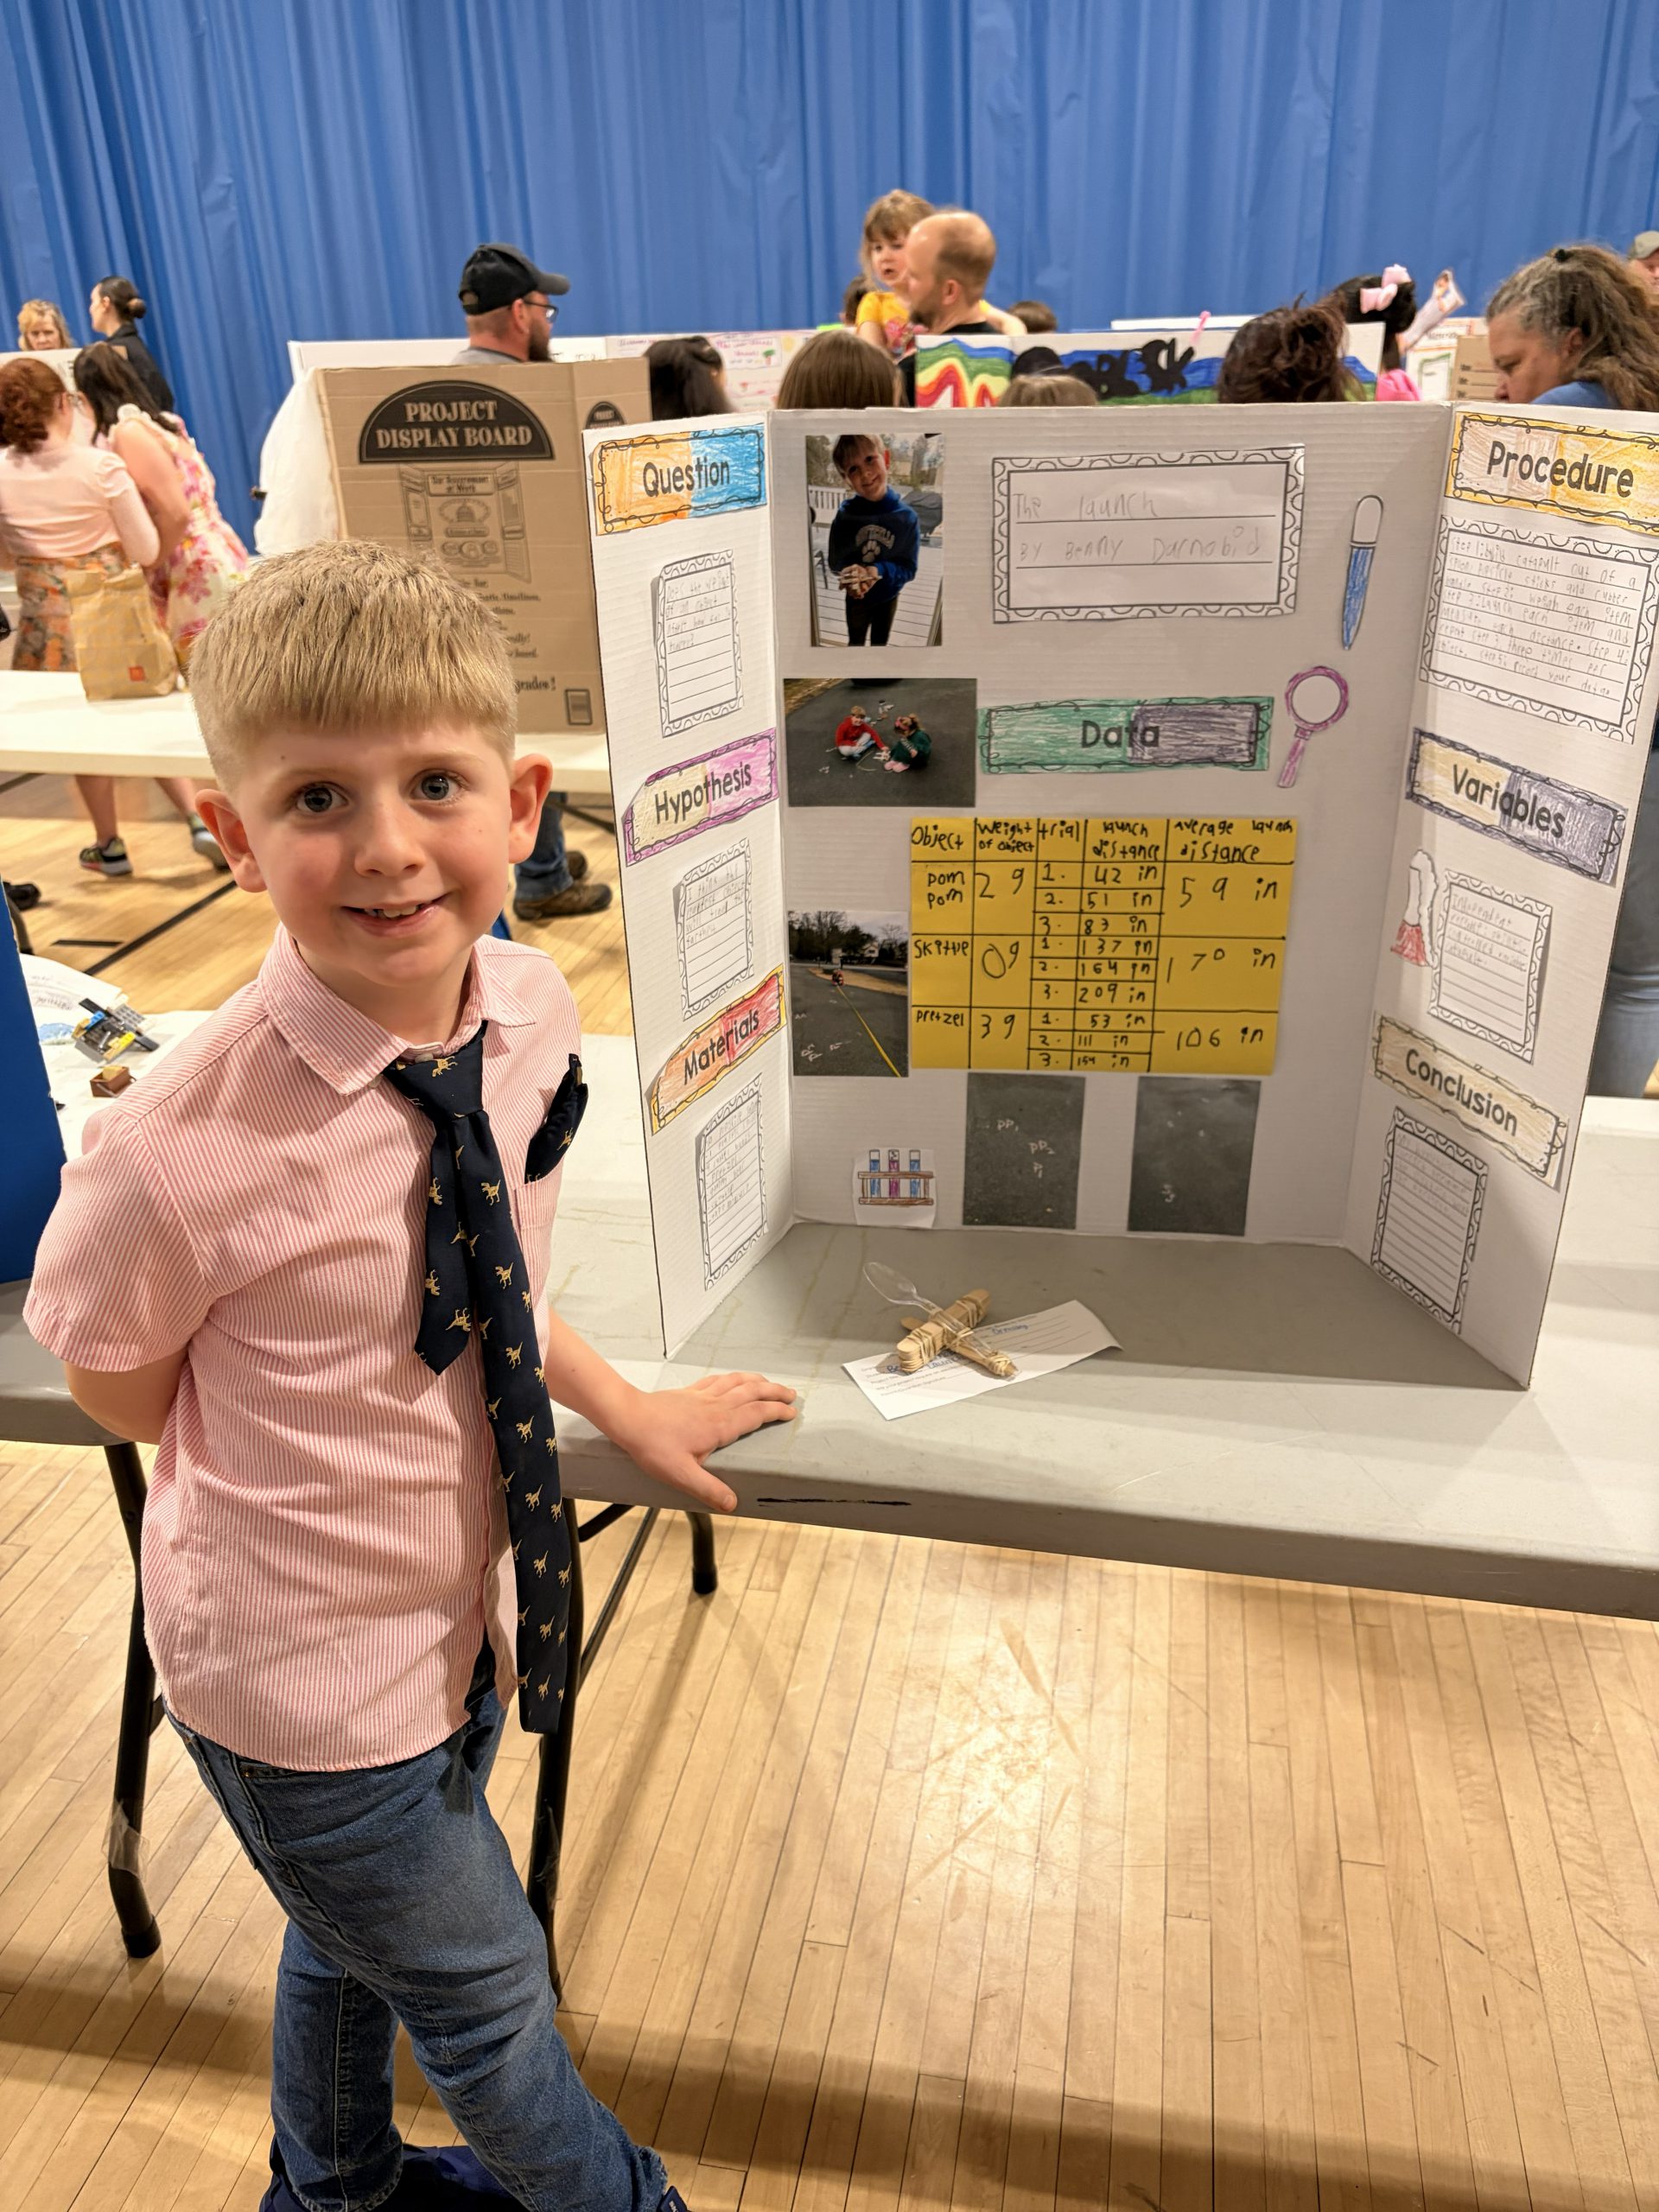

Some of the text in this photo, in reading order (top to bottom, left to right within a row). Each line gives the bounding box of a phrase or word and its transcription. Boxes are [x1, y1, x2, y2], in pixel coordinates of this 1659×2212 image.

[405, 400, 498, 423] PROJECT
[375, 425, 532, 449] DISPLAY BOARD
[642, 456, 731, 498] Question
[1486, 442, 1635, 499] Procedure
[1014, 493, 1042, 519] The
[1081, 720, 1160, 749] Data
[654, 760, 753, 825] Hypothesis
[1452, 765, 1566, 838] Variables
[911, 825, 964, 851] Object
[1095, 867, 1123, 886] 42
[1139, 862, 1159, 881] in
[1045, 892, 1064, 906] 2.
[1133, 890, 1153, 907] in
[1255, 878, 1277, 900] in
[1040, 916, 1147, 936] 3. 83 in
[1135, 938, 1154, 956] in
[1253, 947, 1276, 969] in
[1131, 961, 1151, 976] in
[1043, 982, 1146, 1003] 3. 209 in
[1090, 1014, 1112, 1029] 53
[1127, 1013, 1146, 1027] in
[1113, 1033, 1129, 1046] in
[1241, 1027, 1264, 1045] in
[683, 1008, 760, 1088] Materials
[1112, 1052, 1129, 1067] in
[1405, 1048, 1518, 1136] Conclusion
